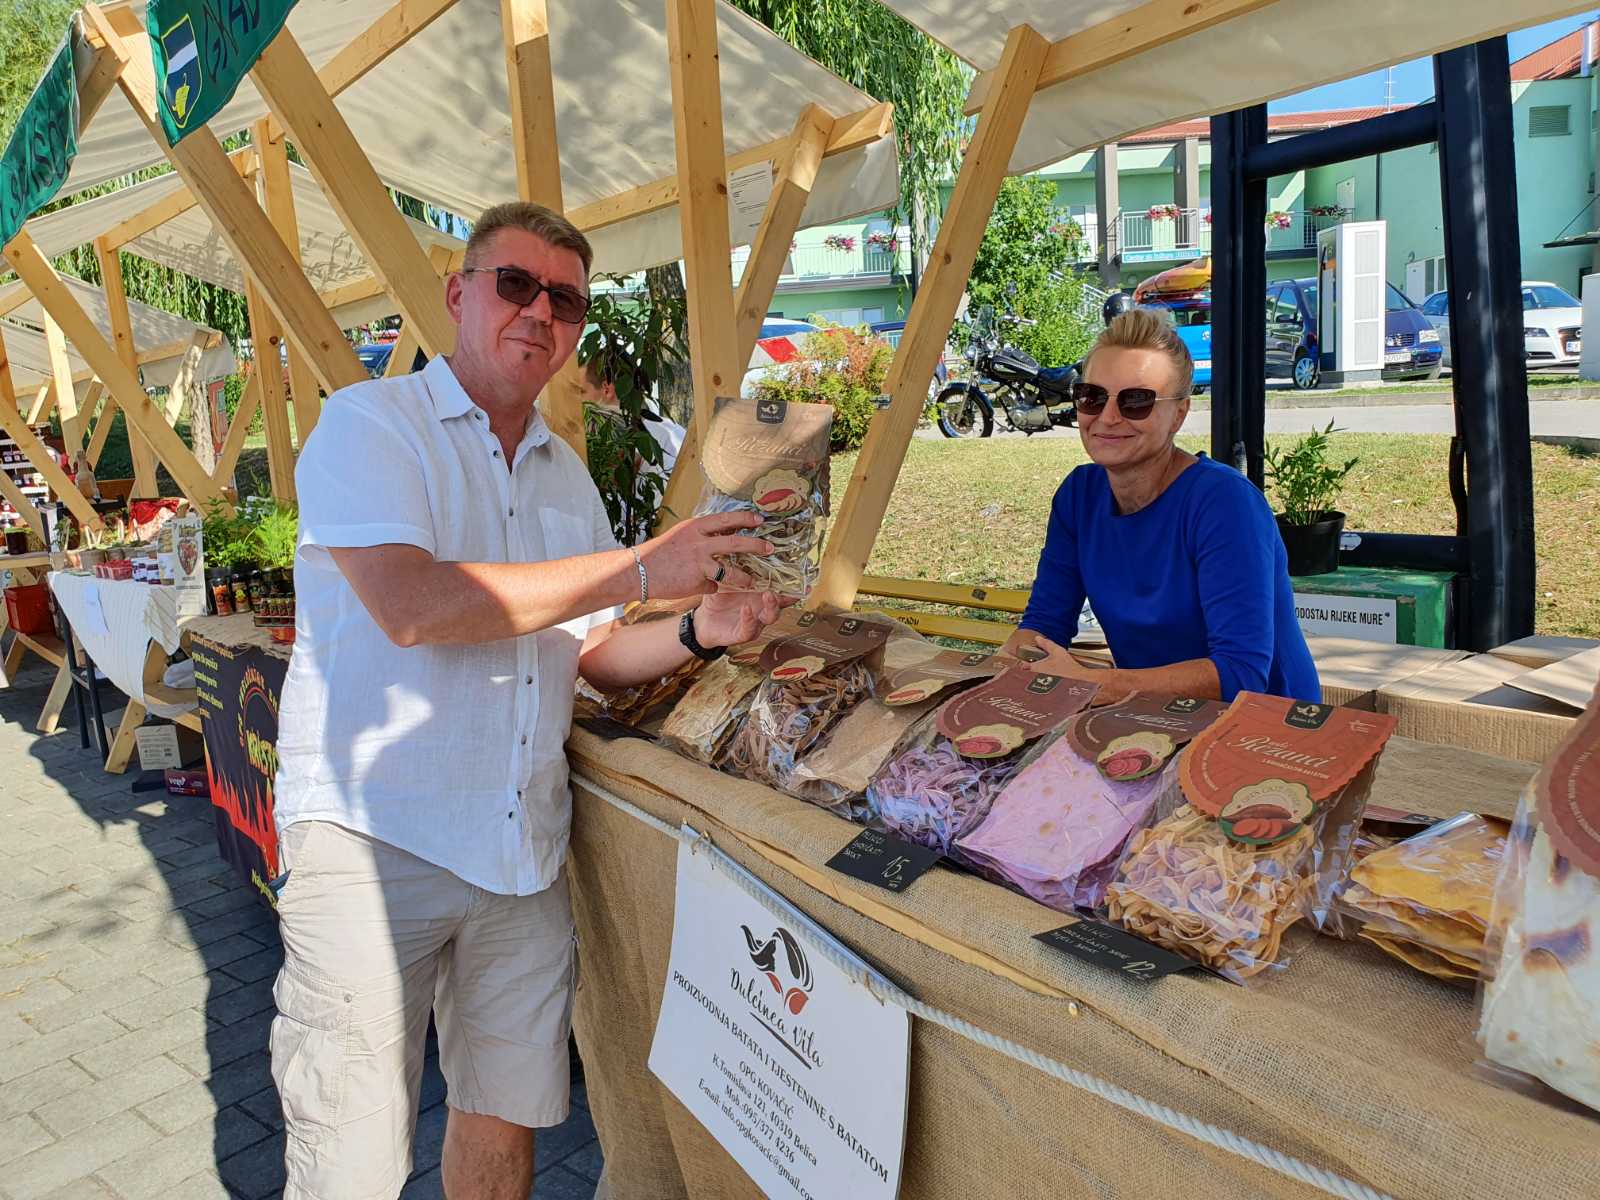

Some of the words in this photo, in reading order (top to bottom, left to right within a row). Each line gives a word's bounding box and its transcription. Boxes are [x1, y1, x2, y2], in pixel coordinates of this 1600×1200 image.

[1295, 607, 1329, 621] ODOSTAJ
[1330, 609, 1357, 624] RIJEKE
[1359, 612, 1384, 626] MURE
[881, 855, 911, 879] 15
[730, 967, 787, 1034] Dulcinea
[792, 1024, 825, 1068] Vita
[673, 969, 730, 1029] PROIZVODNJA
[731, 1020, 763, 1061] BATATA
[770, 1058, 827, 1122] TJESTENINE
[827, 1114, 835, 1129] S
[836, 1121, 889, 1183] BATATOM
[739, 1060, 757, 1084] OPG
[757, 1077, 794, 1121] KOVAČIĆ
[721, 1103, 815, 1200] info.opgkovacic@gmail.co
[770, 1110, 793, 1140] 40319
[793, 1134, 817, 1166] Belica
[774, 1136, 795, 1163] 4236
